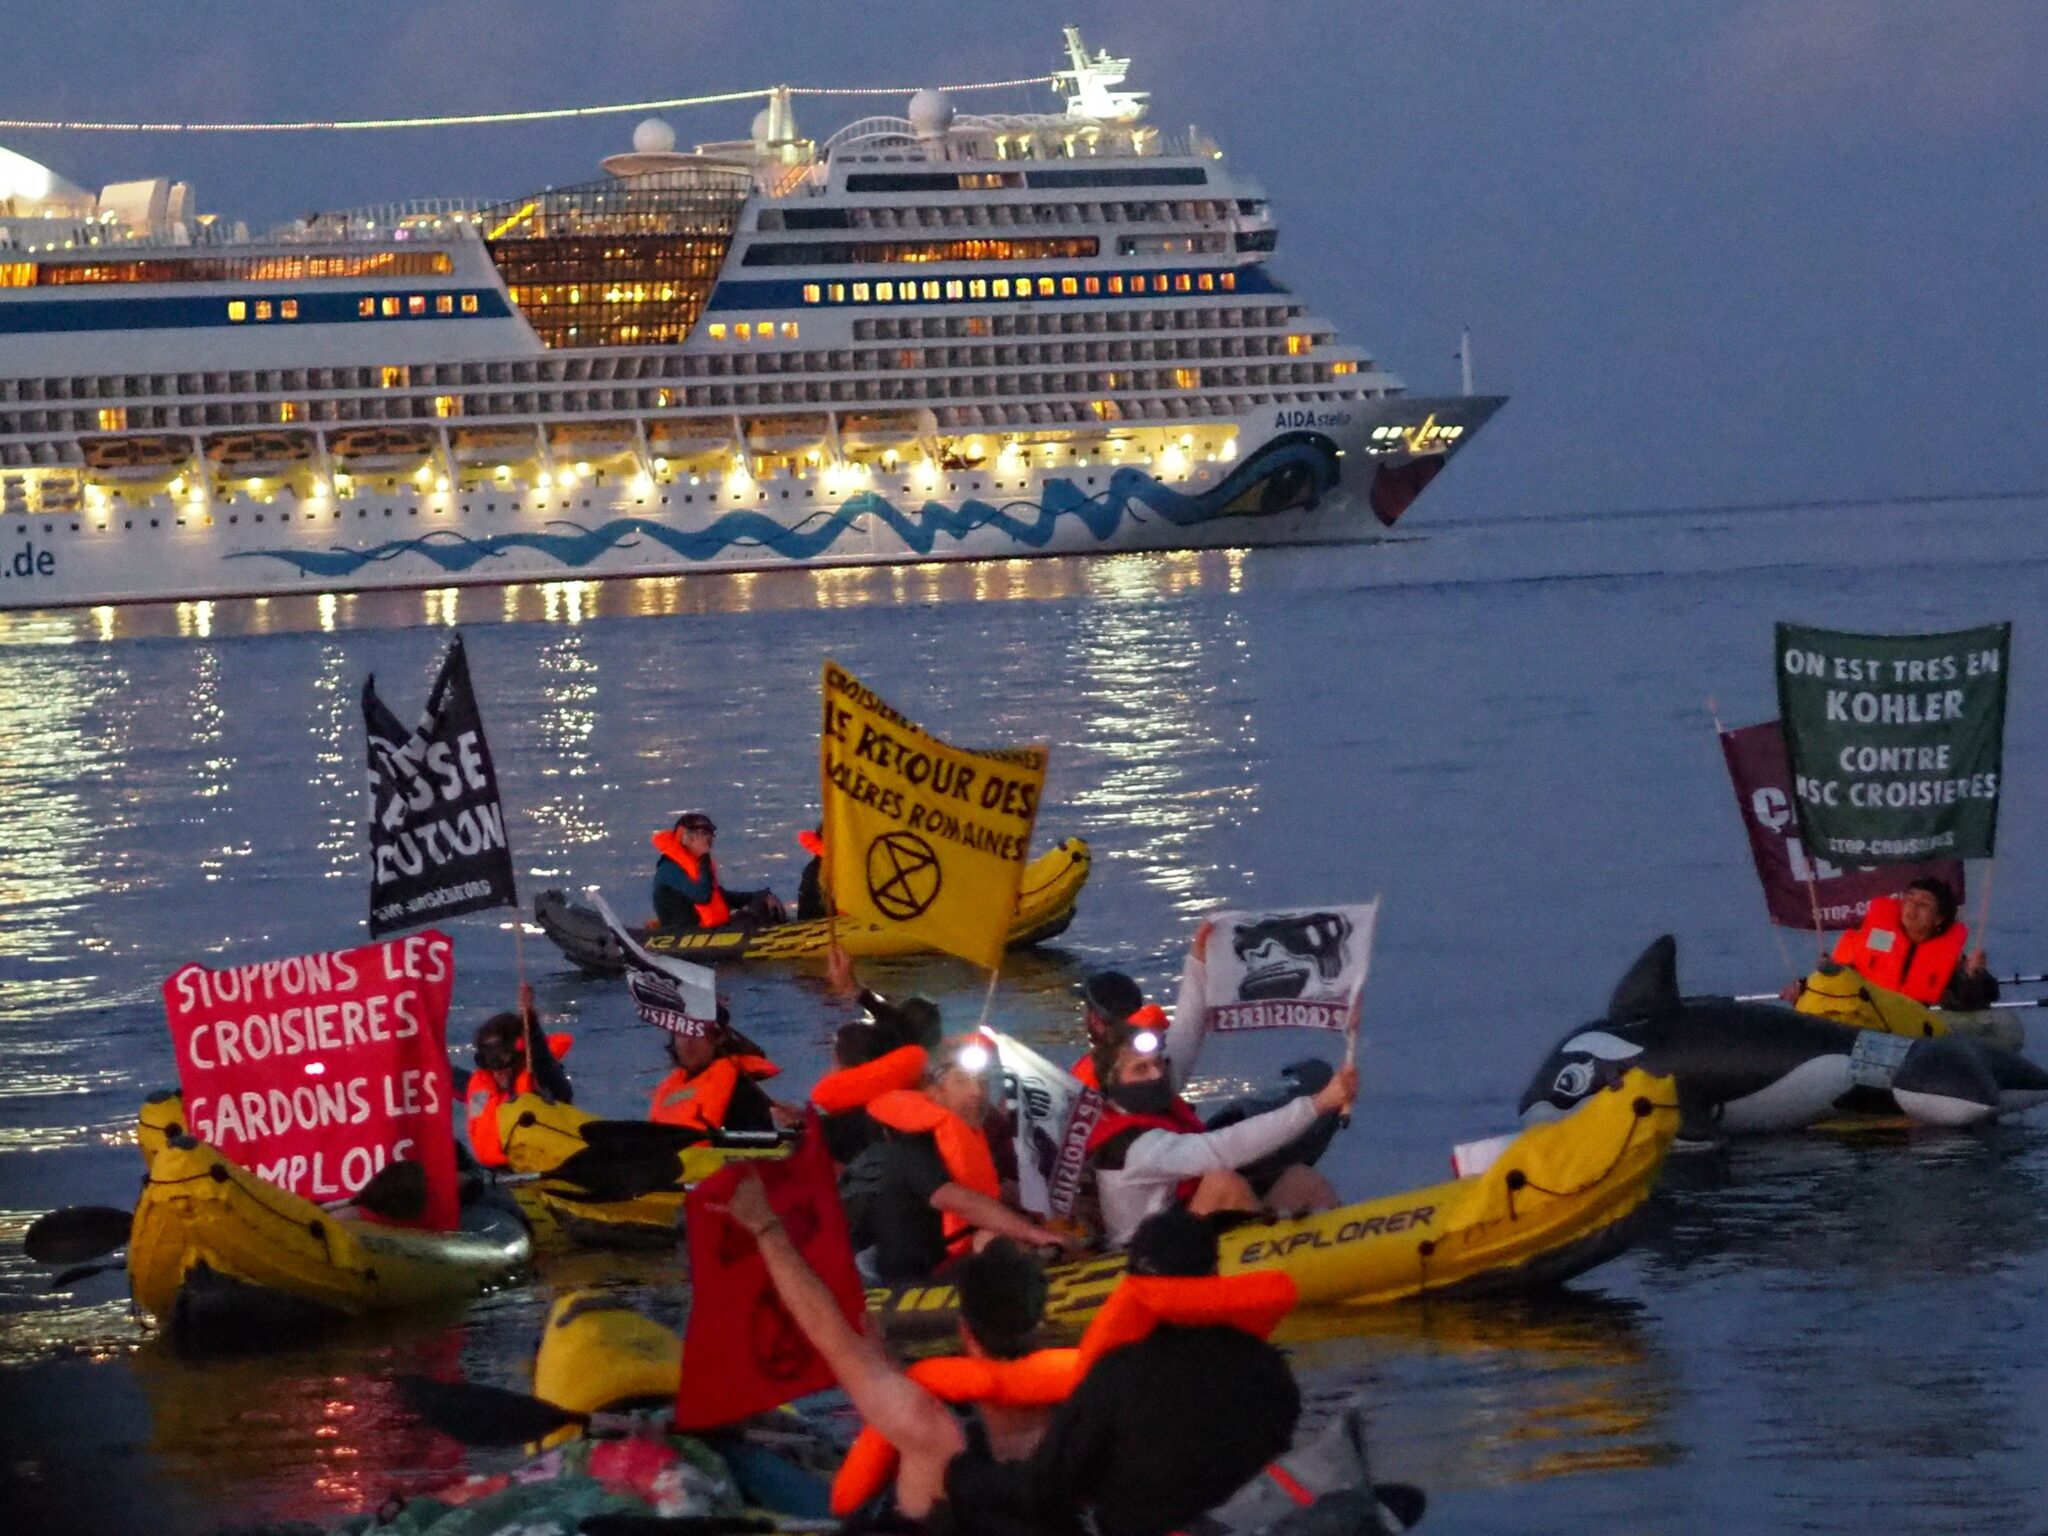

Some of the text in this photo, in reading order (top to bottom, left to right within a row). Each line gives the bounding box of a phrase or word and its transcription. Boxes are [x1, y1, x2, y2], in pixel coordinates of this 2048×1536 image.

[0, 541, 55, 577] .de
[1784, 648, 1999, 682] ON EST TRES EN
[1826, 689, 1964, 724] KOHLER
[856, 722, 976, 802] RETOUR
[981, 776, 1036, 819] DES
[1840, 744, 1950, 773] CONTRE
[1850, 773, 1998, 807] CROISIERES
[908, 803, 1029, 862] ROMAINES
[382, 937, 448, 982] LES
[190, 991, 418, 1069] CROISIERES
[190, 1069, 440, 1146] GARDONS LES
[244, 1139, 414, 1194] MPLOI
[1240, 1206, 1436, 1264] EXPLORER
